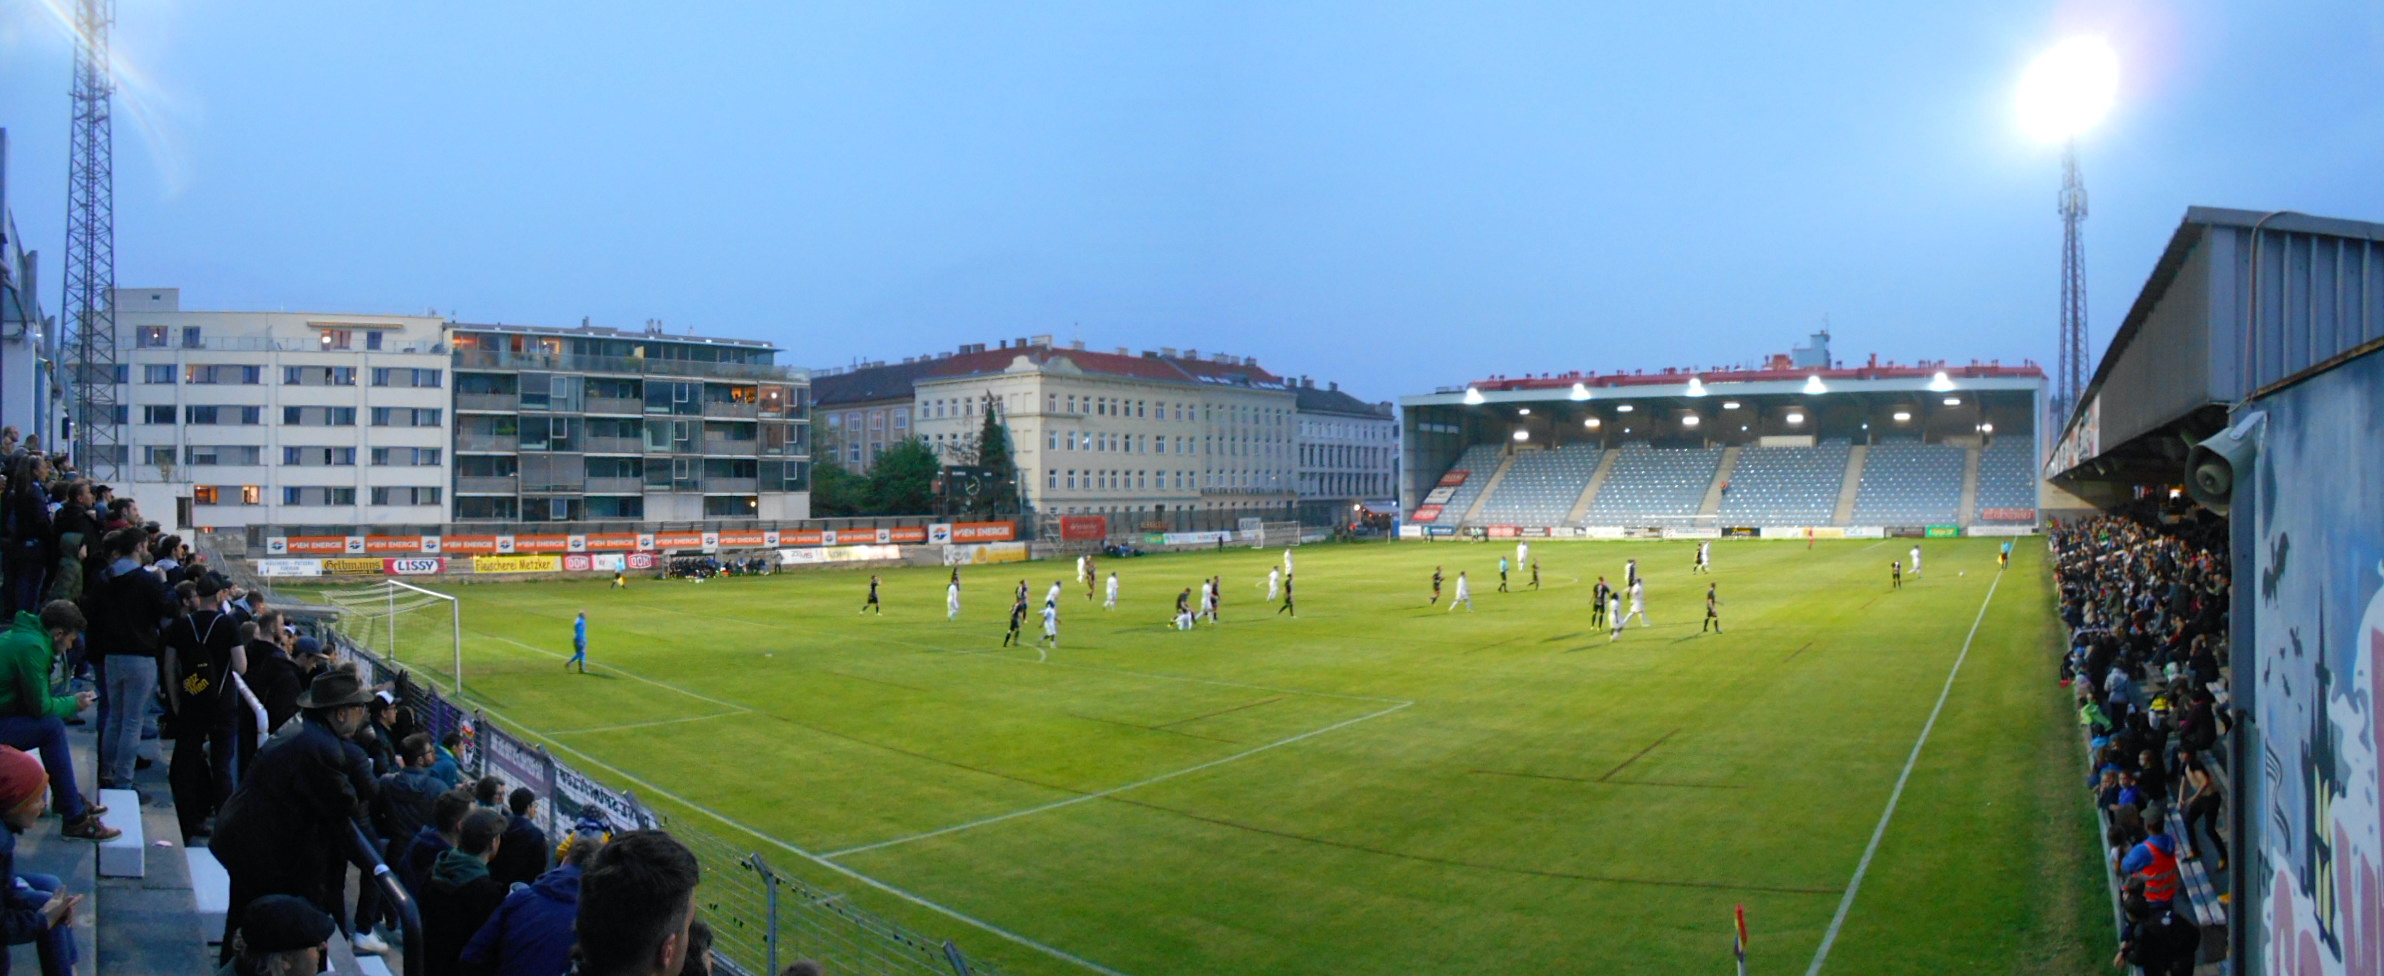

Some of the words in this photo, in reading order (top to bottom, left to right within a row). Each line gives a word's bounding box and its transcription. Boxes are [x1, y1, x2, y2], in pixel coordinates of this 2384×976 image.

[954, 528, 975, 537] WIEN
[977, 527, 1009, 536] ENERGIE
[289, 541, 309, 549] WIEN
[397, 561, 434, 571] LISSY
